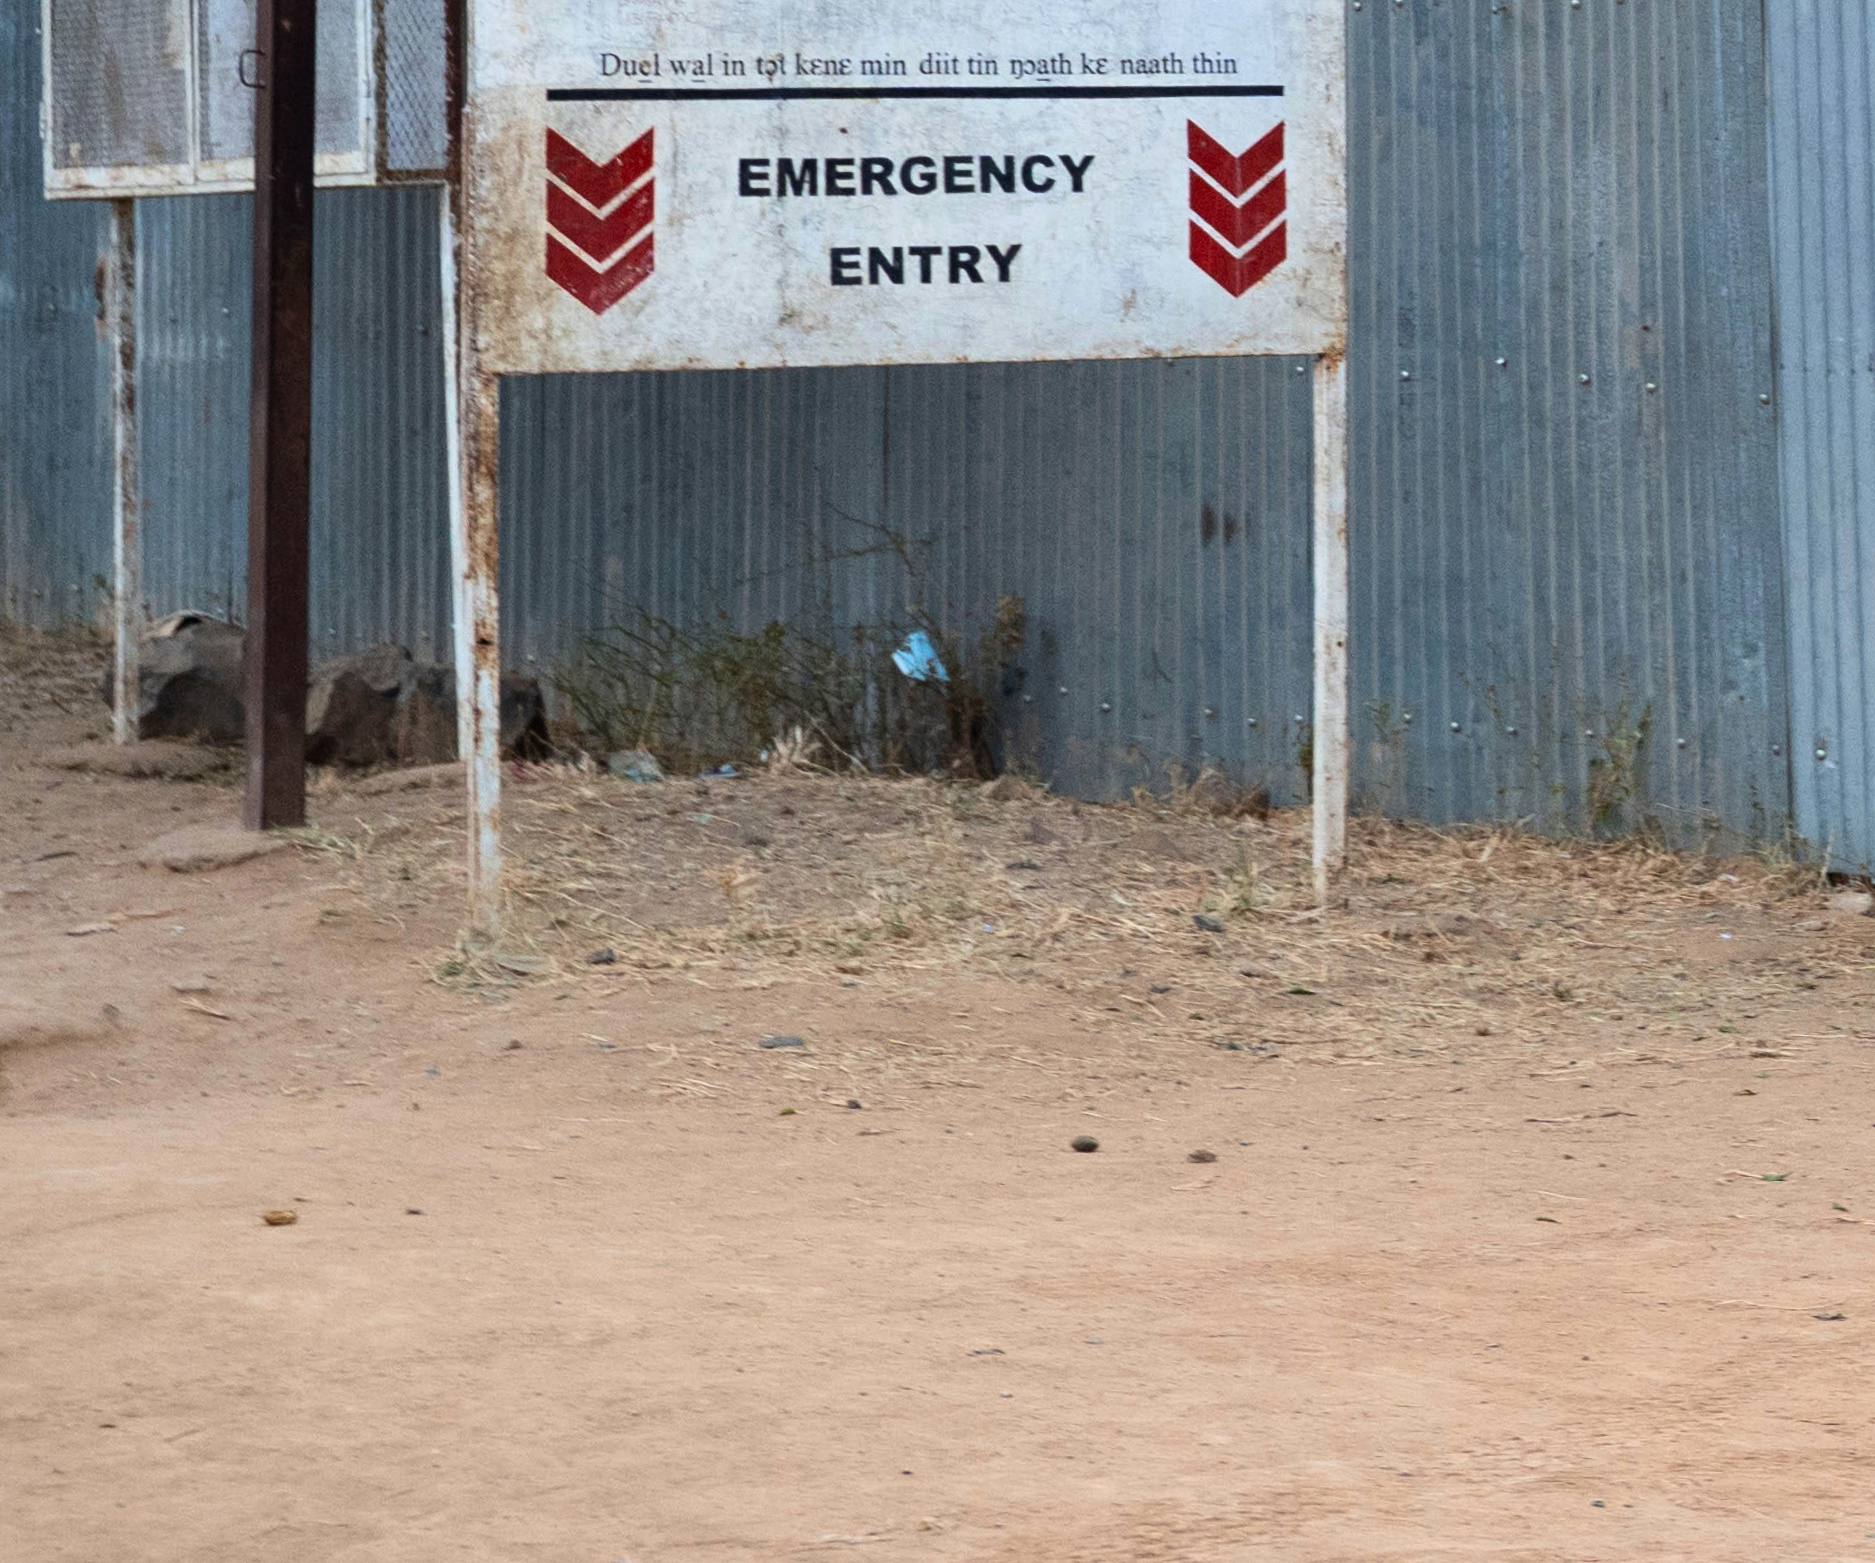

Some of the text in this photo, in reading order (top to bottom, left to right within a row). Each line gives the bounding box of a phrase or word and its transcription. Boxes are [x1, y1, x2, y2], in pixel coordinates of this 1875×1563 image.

[721, 51, 746, 77] in
[860, 52, 907, 76] min
[918, 51, 960, 75] diit
[967, 50, 999, 75] tin
[1120, 50, 1185, 75] naath
[1192, 50, 1238, 75] thin
[737, 154, 1096, 199] EMERGENCY
[829, 243, 1023, 287] ENTRY
